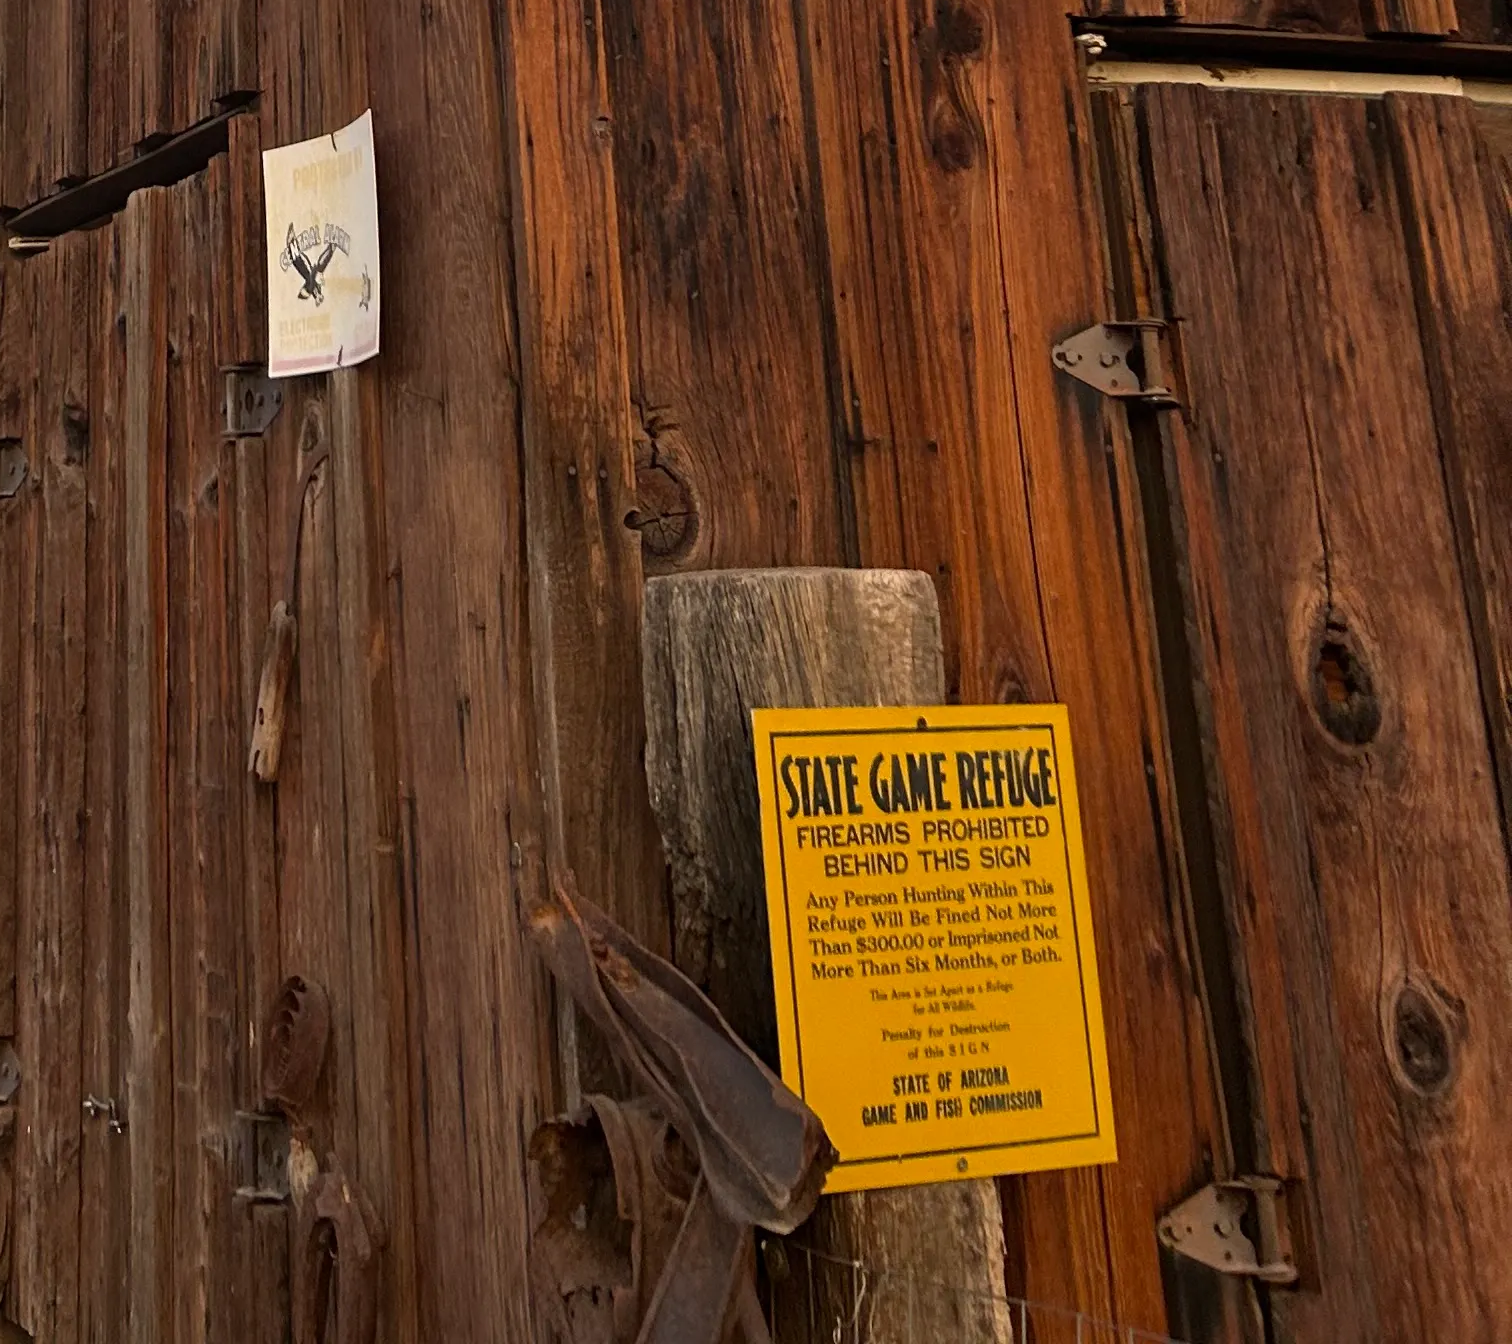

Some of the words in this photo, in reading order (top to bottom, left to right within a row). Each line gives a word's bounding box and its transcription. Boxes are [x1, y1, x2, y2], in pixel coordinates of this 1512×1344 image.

[781, 752, 863, 819] STATE
[869, 752, 952, 813] GAME
[955, 747, 1056, 810] REFUGE
[796, 821, 910, 849] FIREARMS
[922, 815, 1050, 843] PROHIBITED
[823, 851, 909, 878] BEHIND
[917, 847, 970, 872] THIS
[979, 844, 1031, 869] SIGN
[807, 892, 838, 911] Any
[844, 890, 898, 907] Person
[902, 884, 965, 904] Hunting
[968, 880, 1018, 898] Within
[1021, 878, 1054, 896] This
[807, 914, 866, 934] Refuge
[871, 911, 903, 928] Will
[910, 909, 929, 926] Be
[936, 905, 980, 924] Fined
[986, 904, 1013, 921] Not
[1018, 902, 1056, 919] More
[809, 937, 852, 956] Than
[856, 932, 924, 954] $300.00
[928, 935, 944, 948] or
[948, 925, 1030, 949] Imprisoned
[1033, 923, 1059, 940] Not
[811, 961, 854, 980] More
[857, 958, 901, 977] Than
[905, 955, 930, 973] Six
[935, 951, 998, 971] Months,
[1002, 952, 1017, 966] or
[1022, 945, 1062, 965] Both.
[880, 1027, 922, 1042] Penalty
[928, 1025, 944, 1038] for
[949, 1020, 1010, 1037] Destruction
[907, 1046, 919, 1060] of
[924, 1044, 944, 1058] this
[892, 1073, 930, 1096] STATE
[938, 1071, 953, 1093] OF
[961, 1065, 1010, 1090] ARIZONA
[862, 1103, 897, 1128] GAME
[905, 1101, 929, 1123] AND
[936, 1096, 963, 1120] FISH
[969, 1089, 1044, 1117] COMMISSION
